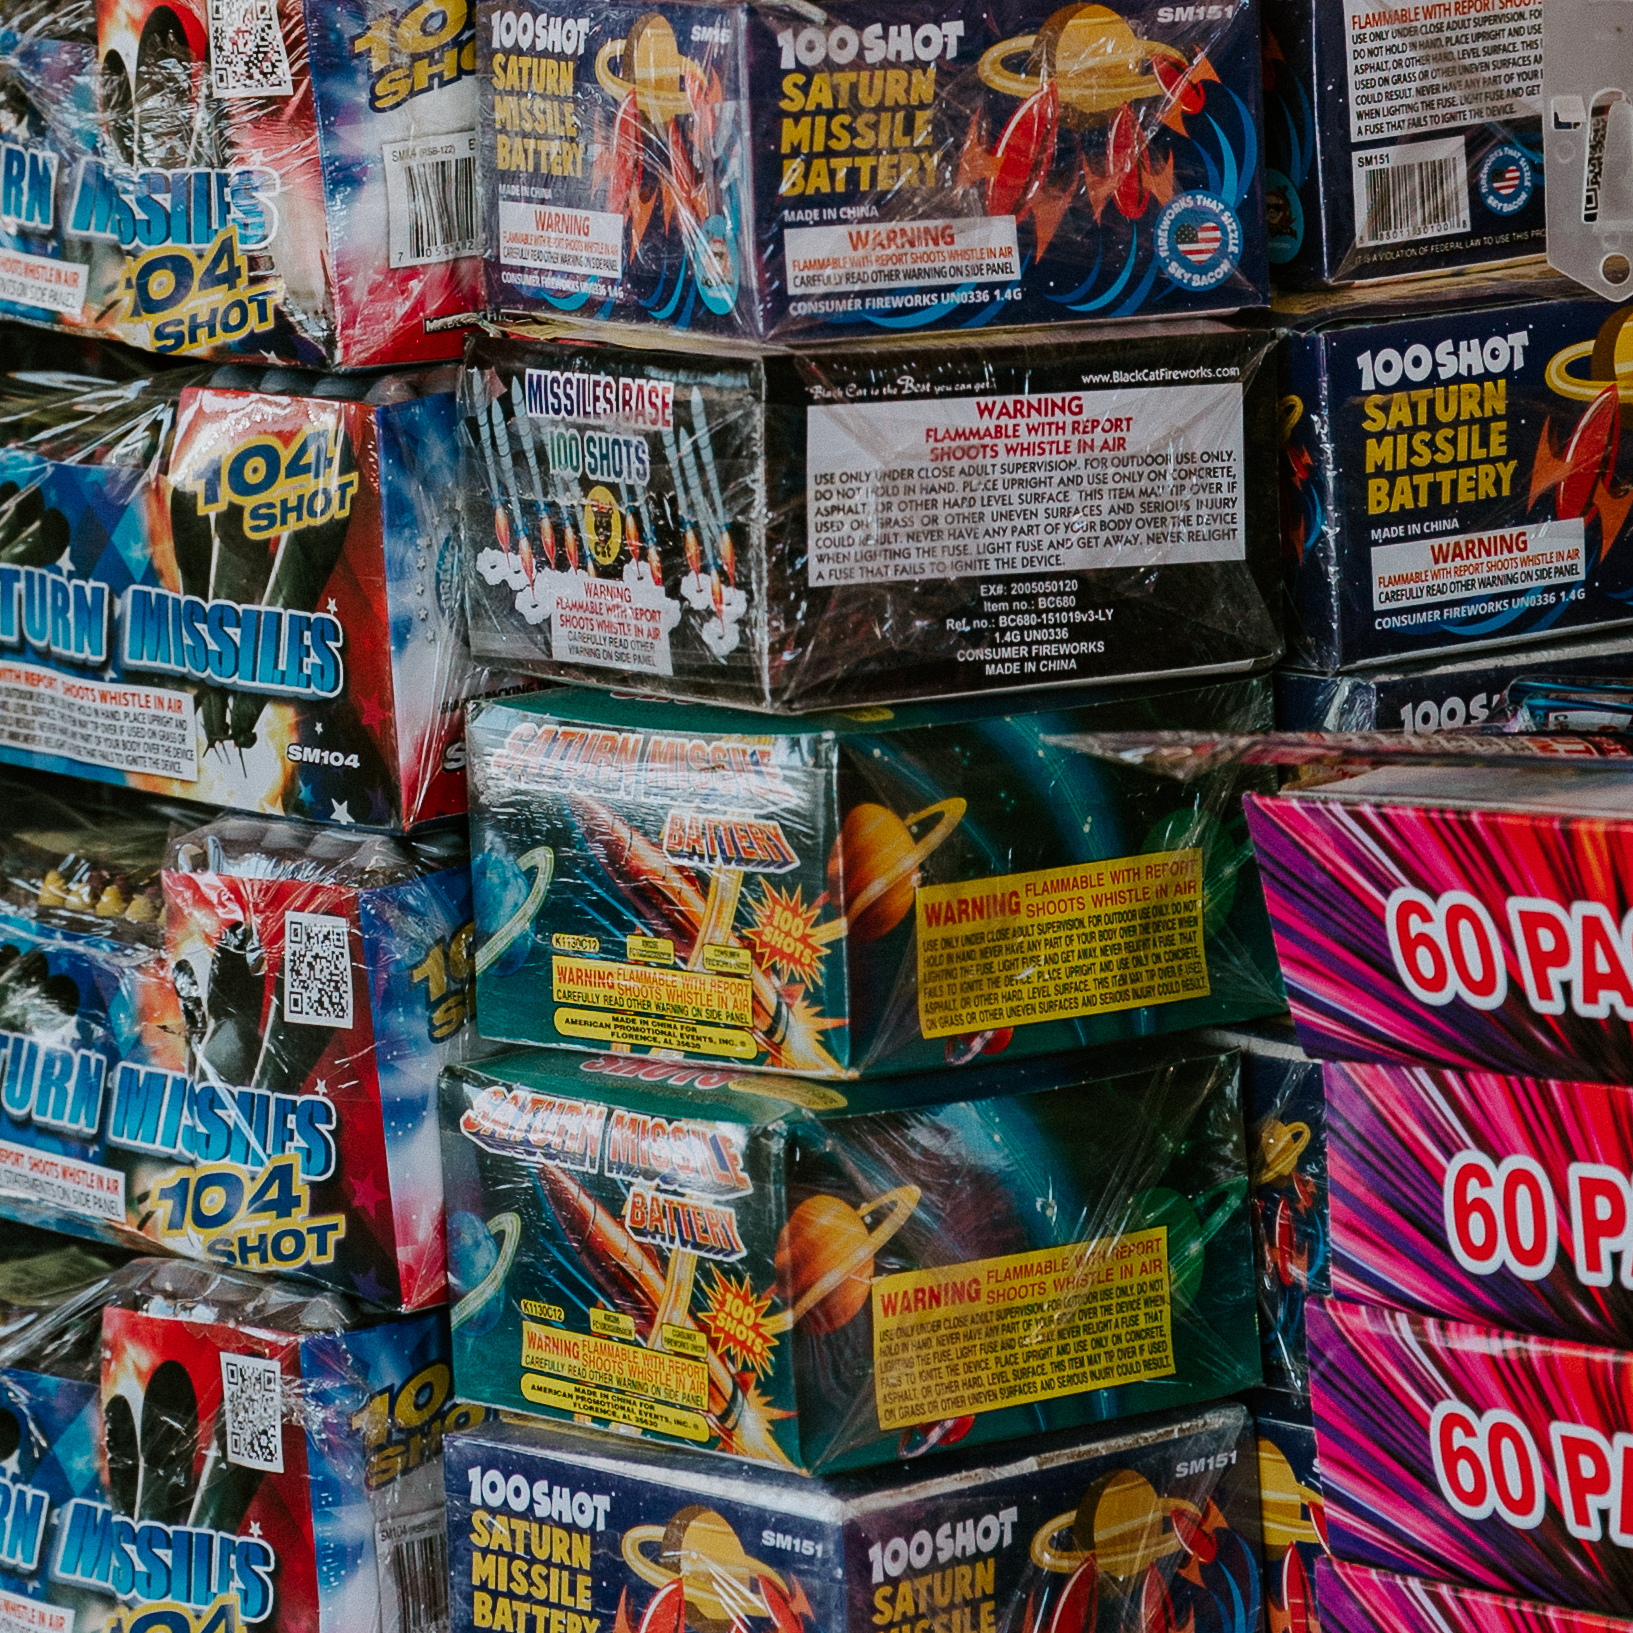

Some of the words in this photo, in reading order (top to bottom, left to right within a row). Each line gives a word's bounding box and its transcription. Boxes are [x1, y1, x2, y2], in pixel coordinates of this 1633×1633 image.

[1352, 8, 1420, 30] FLAMMABLE
[1422, 3, 1451, 21] WITH
[492, 54, 574, 95] SATURN
[781, 68, 936, 112] SATURN
[495, 95, 577, 134] MISSILE
[780, 110, 933, 153] MISSILE
[496, 136, 584, 177] BATTERY
[783, 150, 942, 197] BATTERY
[1357, 154, 1390, 168] SM151
[535, 210, 590, 236] WARNING
[783, 207, 822, 223] MADE
[824, 207, 836, 220] IN
[848, 223, 955, 252] WARNING
[985, 263, 1014, 276] PANEL
[151, 279, 284, 354] SHOT
[789, 296, 862, 316] CONSUMER
[866, 292, 939, 311] FIREWORKS
[994, 288, 1022, 302] 1.4G
[1082, 366, 1240, 385] www.BlackCatFireworks.com
[527, 370, 616, 421] MISSILES
[620, 381, 673, 428] BASE
[976, 396, 1083, 420] WARNING
[1362, 379, 1507, 433] SATURN
[925, 423, 1020, 444] FLAMMABLE
[1026, 420, 1067, 439] WITH
[1071, 416, 1133, 435] REPORT
[1365, 422, 1508, 474] MISSILE
[549, 429, 580, 472] 100
[585, 432, 649, 483] SHOTS
[929, 443, 999, 463] SHOOTS
[1004, 439, 1073, 458] WHISTLE
[1077, 439, 1095, 454] IN
[1099, 436, 1127, 453] AIR
[187, 426, 348, 516] 104
[1367, 460, 1517, 515] BATTERY
[244, 471, 359, 540] SHOT
[1371, 526, 1405, 541] MADE
[1407, 523, 1421, 535] IN
[1423, 518, 1459, 534] CHINA
[1430, 532, 1528, 565] WARNING
[1378, 570, 1429, 588] FLAMMABLE
[1430, 566, 1452, 580] WITH
[1453, 562, 1484, 577] REPORT
[1486, 557, 1519, 572] SHOOTS
[1519, 551, 1554, 567] WHISTLE
[1038, 595, 1076, 610] BC680
[1375, 611, 1440, 631] CONSUMER
[1443, 599, 1510, 620] FIREWORKS
[1560, 588, 1585, 603] 1.4G
[559, 614, 595, 631] SHOOTS
[994, 631, 1021, 644] 1.4G
[125, 584, 343, 699] MISSILES
[956, 645, 1028, 662] CONSUMER
[1031, 640, 1105, 657] FIREWORKS
[985, 662, 1020, 677] MADE
[1024, 661, 1036, 674] IN
[1039, 658, 1077, 672] CHINA
[287, 743, 361, 769] SM104
[664, 810, 800, 873] BATTERY
[1025, 872, 1105, 898] FLAMMABLE
[1109, 866, 1143, 886] WITH
[1025, 894, 1087, 919] SHOOTS
[1091, 885, 1152, 909] WHISTLE
[1173, 879, 1197, 897] AIR
[772, 906, 804, 936] 100
[923, 890, 1021, 929] WARNING
[761, 930, 811, 966] SHOTS
[1386, 887, 1508, 1011] 60
[557, 964, 614, 990] WARNING
[617, 985, 662, 1001] SHOOTS
[666, 990, 713, 1007] WHISTLE
[718, 995, 728, 1009] IN
[733, 998, 749, 1012] AIR
[565, 1018, 611, 1030] AMERICAN
[612, 1016, 637, 1024] MADE
[680, 1025, 697, 1033] FOR
[460, 1086, 607, 1173] SATURN
[605, 1108, 752, 1199] MISSILE
[152, 1153, 309, 1236] 104
[626, 1190, 747, 1260] BATTERY
[1444, 1149, 1558, 1282] 60
[203, 1215, 346, 1271] SHOT
[880, 1277, 981, 1318] WARNING
[986, 1283, 1047, 1306] SHOOTS
[527, 1332, 580, 1360] WARNING
[1175, 1450, 1238, 1478] SM151
[1429, 1399, 1547, 1530] 60
[469, 1508, 592, 1571] SATURN
[762, 1529, 824, 1559] SM151
[471, 1549, 593, 1612] MISSILE
[871, 1558, 995, 1625] SATURN
